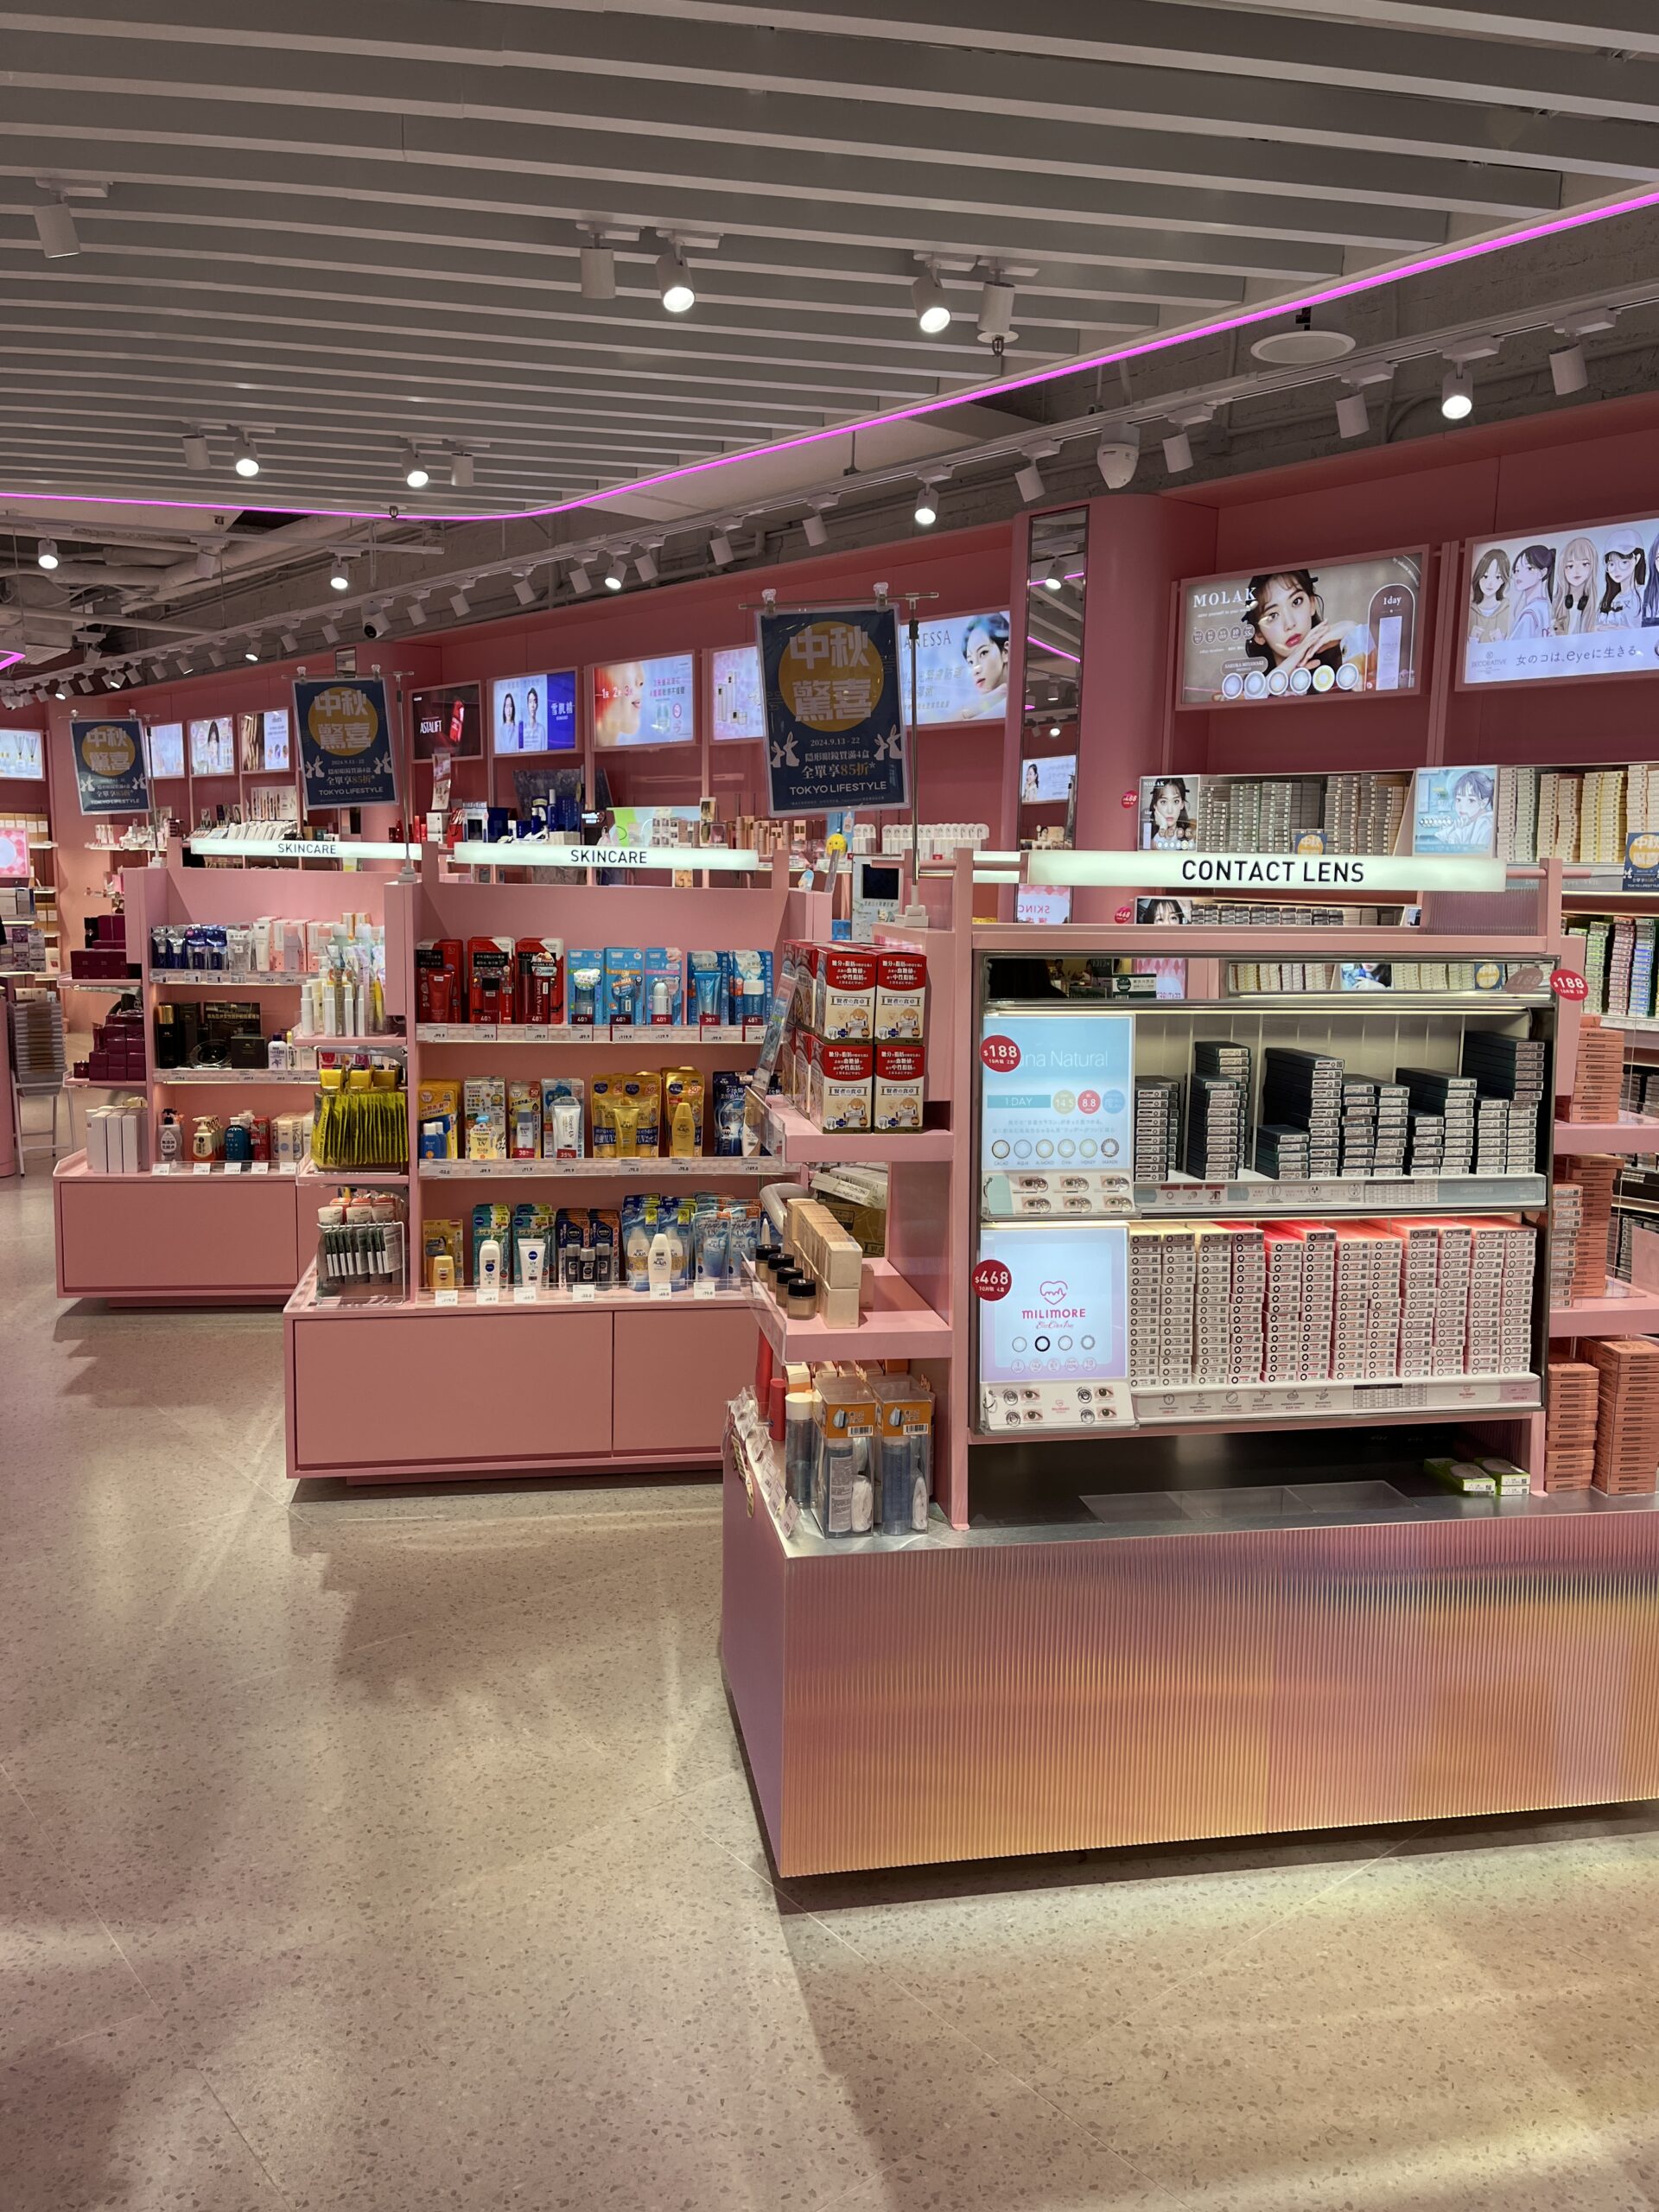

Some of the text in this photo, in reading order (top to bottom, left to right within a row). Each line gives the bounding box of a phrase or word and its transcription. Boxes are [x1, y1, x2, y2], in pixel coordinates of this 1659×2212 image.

[1193, 587, 1257, 607] MOLAK
[1383, 595, 1402, 606] 1day
[790, 626, 871, 670] 中秋
[315, 690, 368, 717] 中秋
[792, 678, 873, 722] 驚喜
[550, 701, 574, 715] 雪肌精
[420, 720, 442, 734] ASTALIFT
[86, 728, 128, 747] 中秋
[317, 721, 372, 750] 驚喜
[810, 737, 846, 747] 2024.9.13
[345, 786, 384, 795] LIFESTYLE
[789, 780, 887, 796] TOKYO LIFESTYLE
[277, 843, 336, 854] SKINCARE
[571, 849, 647, 863] SKINCARE
[1182, 860, 1364, 882] CONTACT LENS
[1554, 977, 1585, 988] $188
[983, 1045, 1018, 1058] $188
[1051, 1050, 1109, 1067] Natural
[1082, 1098, 1096, 1107] 8.8
[975, 1271, 1008, 1285] $468
[1022, 1308, 1086, 1319] MILIMORE
